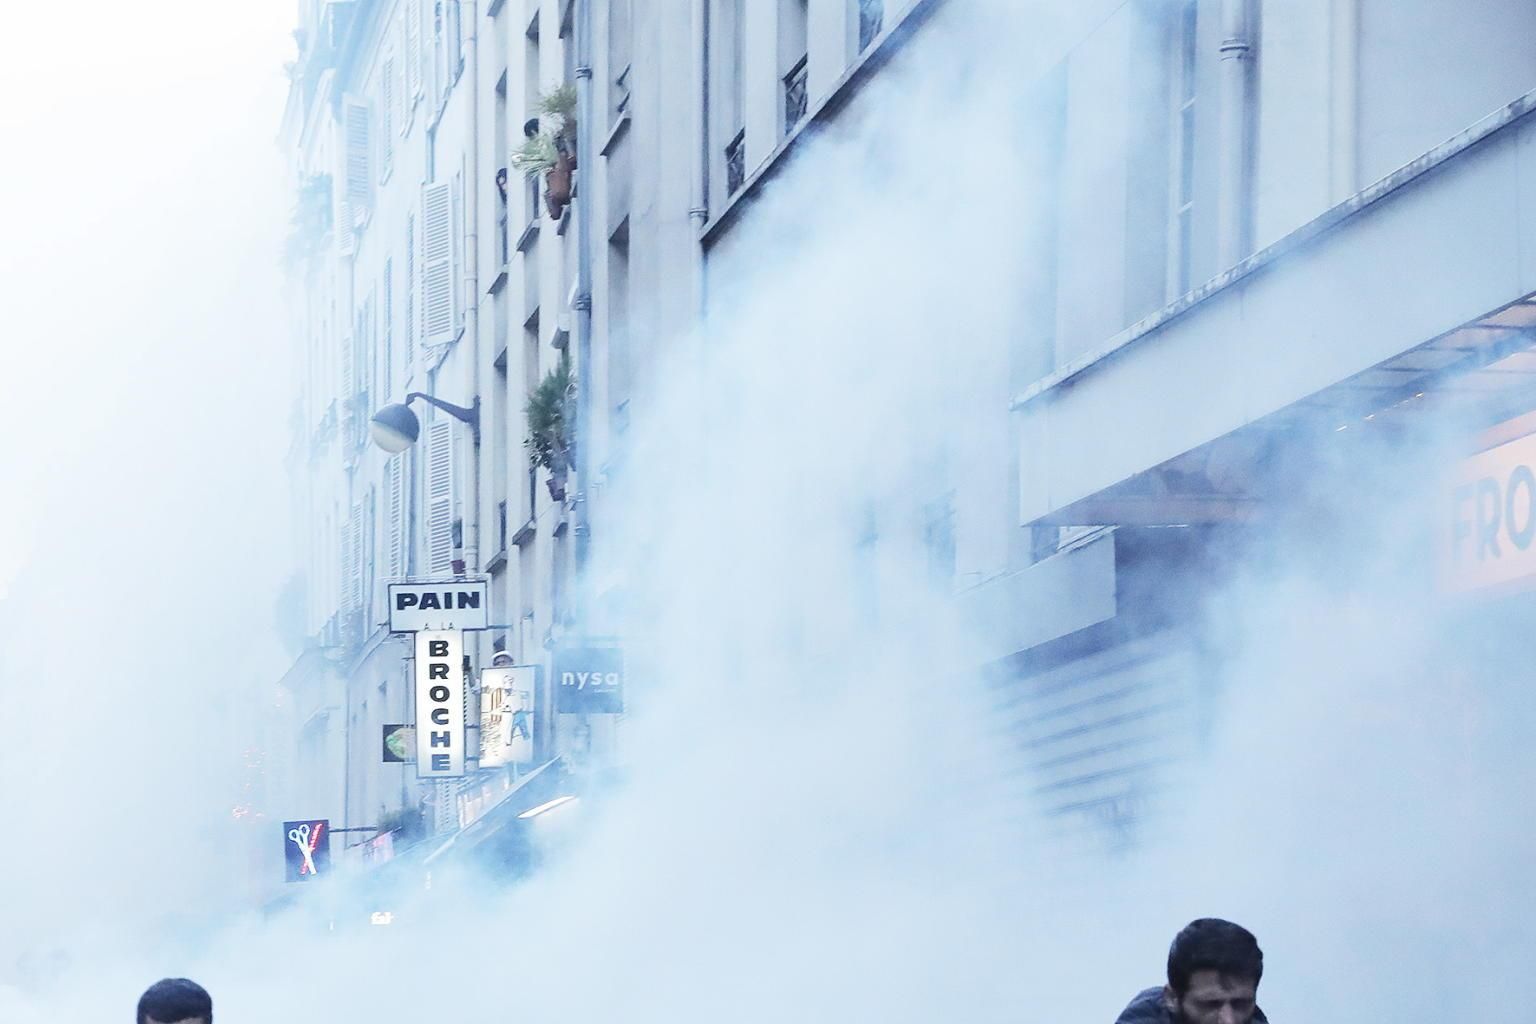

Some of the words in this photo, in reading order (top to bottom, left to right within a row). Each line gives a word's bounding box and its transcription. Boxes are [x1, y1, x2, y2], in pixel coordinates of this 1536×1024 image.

[396, 591, 480, 611] PAIN
[561, 671, 619, 690] nysa
[429, 640, 451, 771] BROCHE
